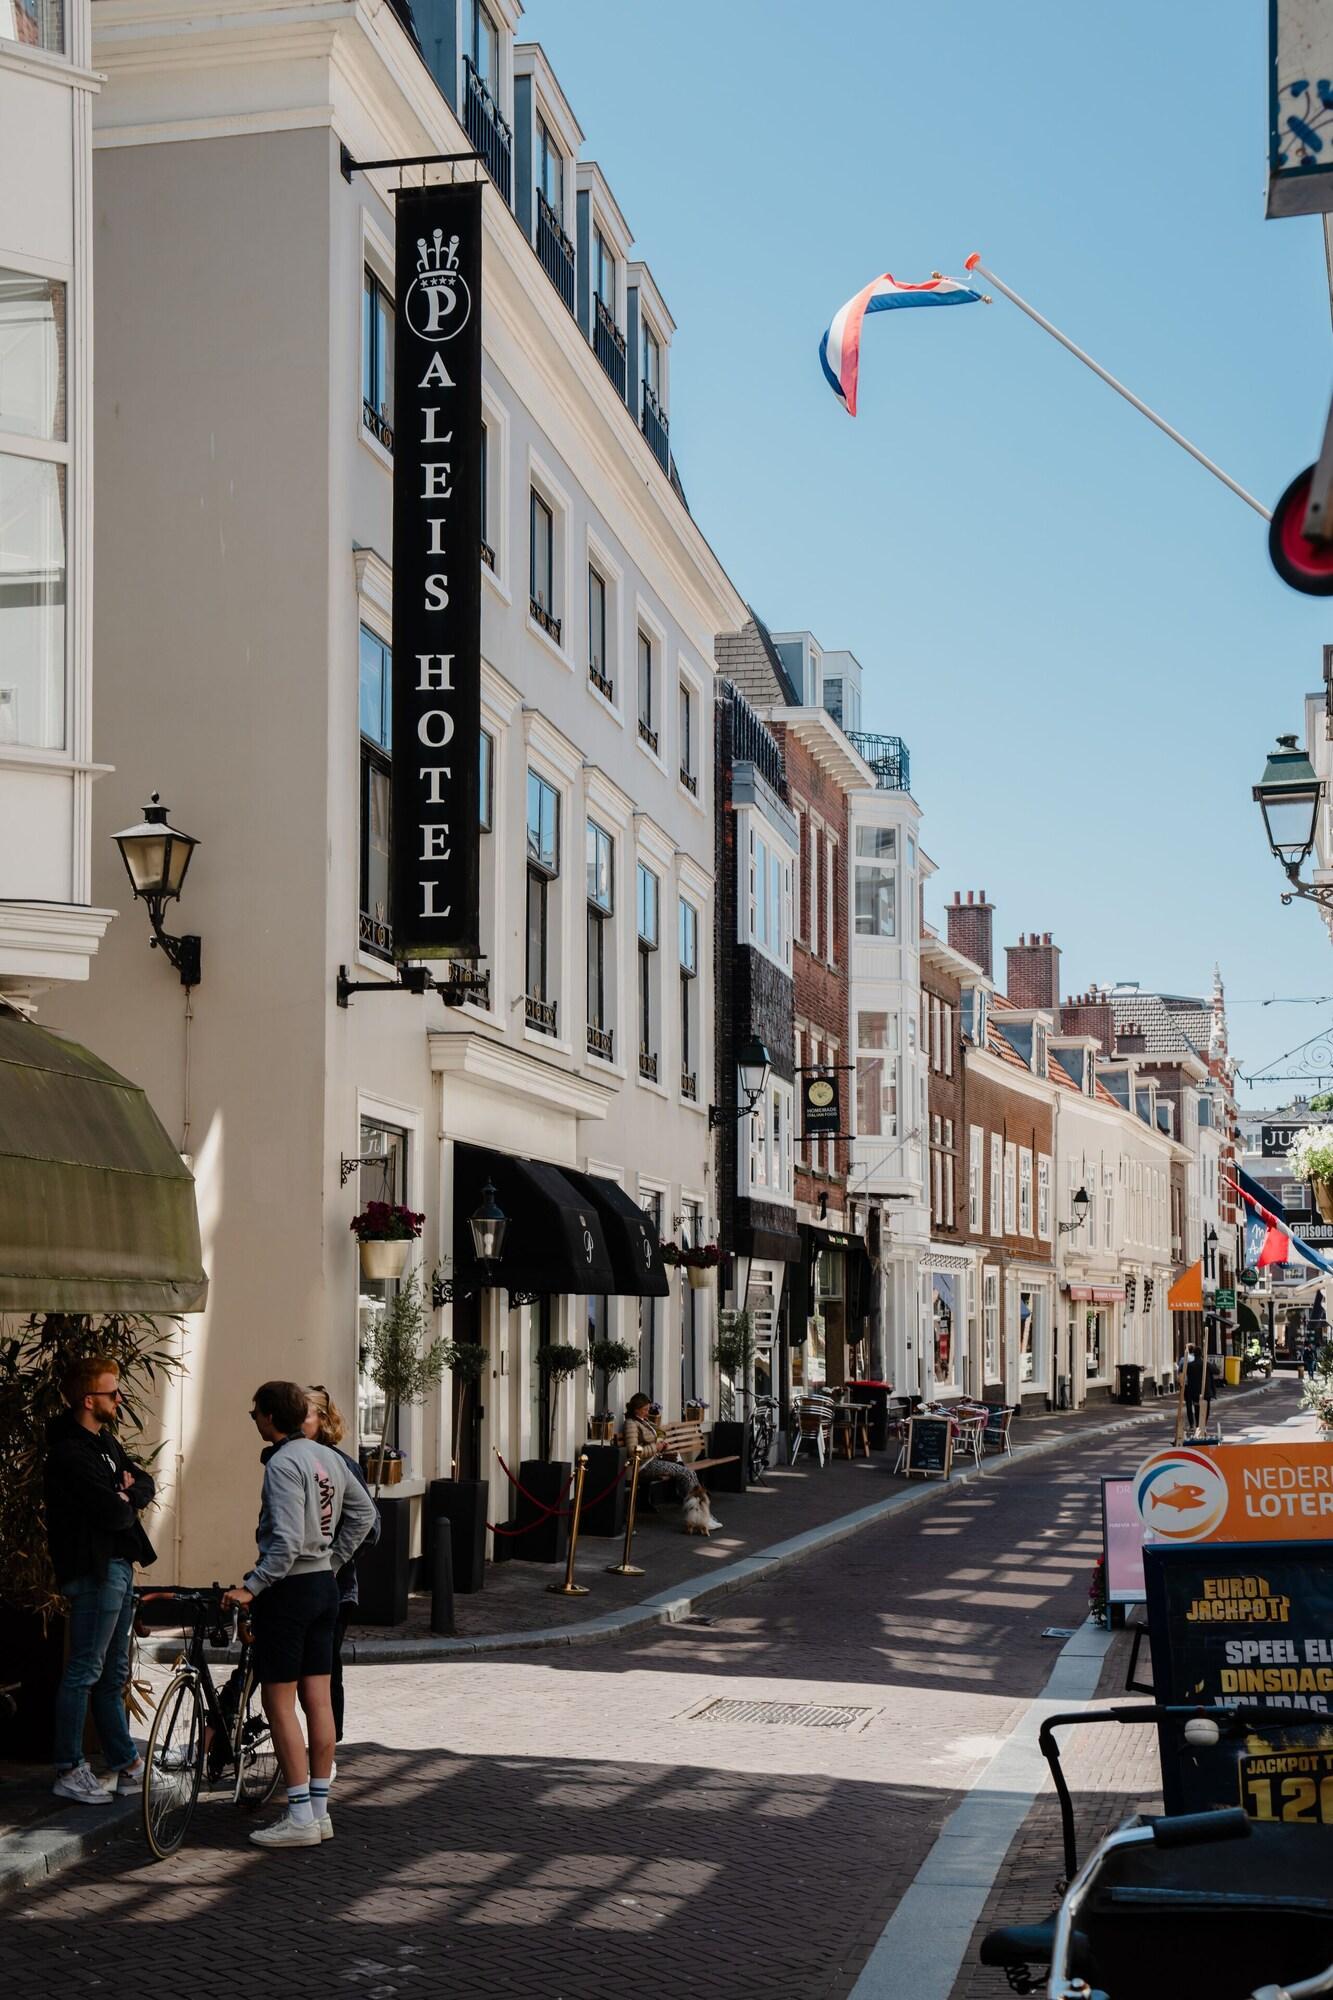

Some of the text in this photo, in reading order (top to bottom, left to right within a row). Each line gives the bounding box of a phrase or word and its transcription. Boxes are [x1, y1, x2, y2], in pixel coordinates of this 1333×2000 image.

[414, 285, 458, 918] PALEIS HOTEL
[1242, 1465, 1333, 1490] NEDER
[1203, 1577, 1259, 1600] EURO
[1186, 1598, 1281, 1622] JACKPOT
[1225, 1639, 1333, 1664] SPEEL EL
[1220, 1668, 1333, 1693] DINSDAG
[1246, 1756, 1319, 1775] JACKPOT
